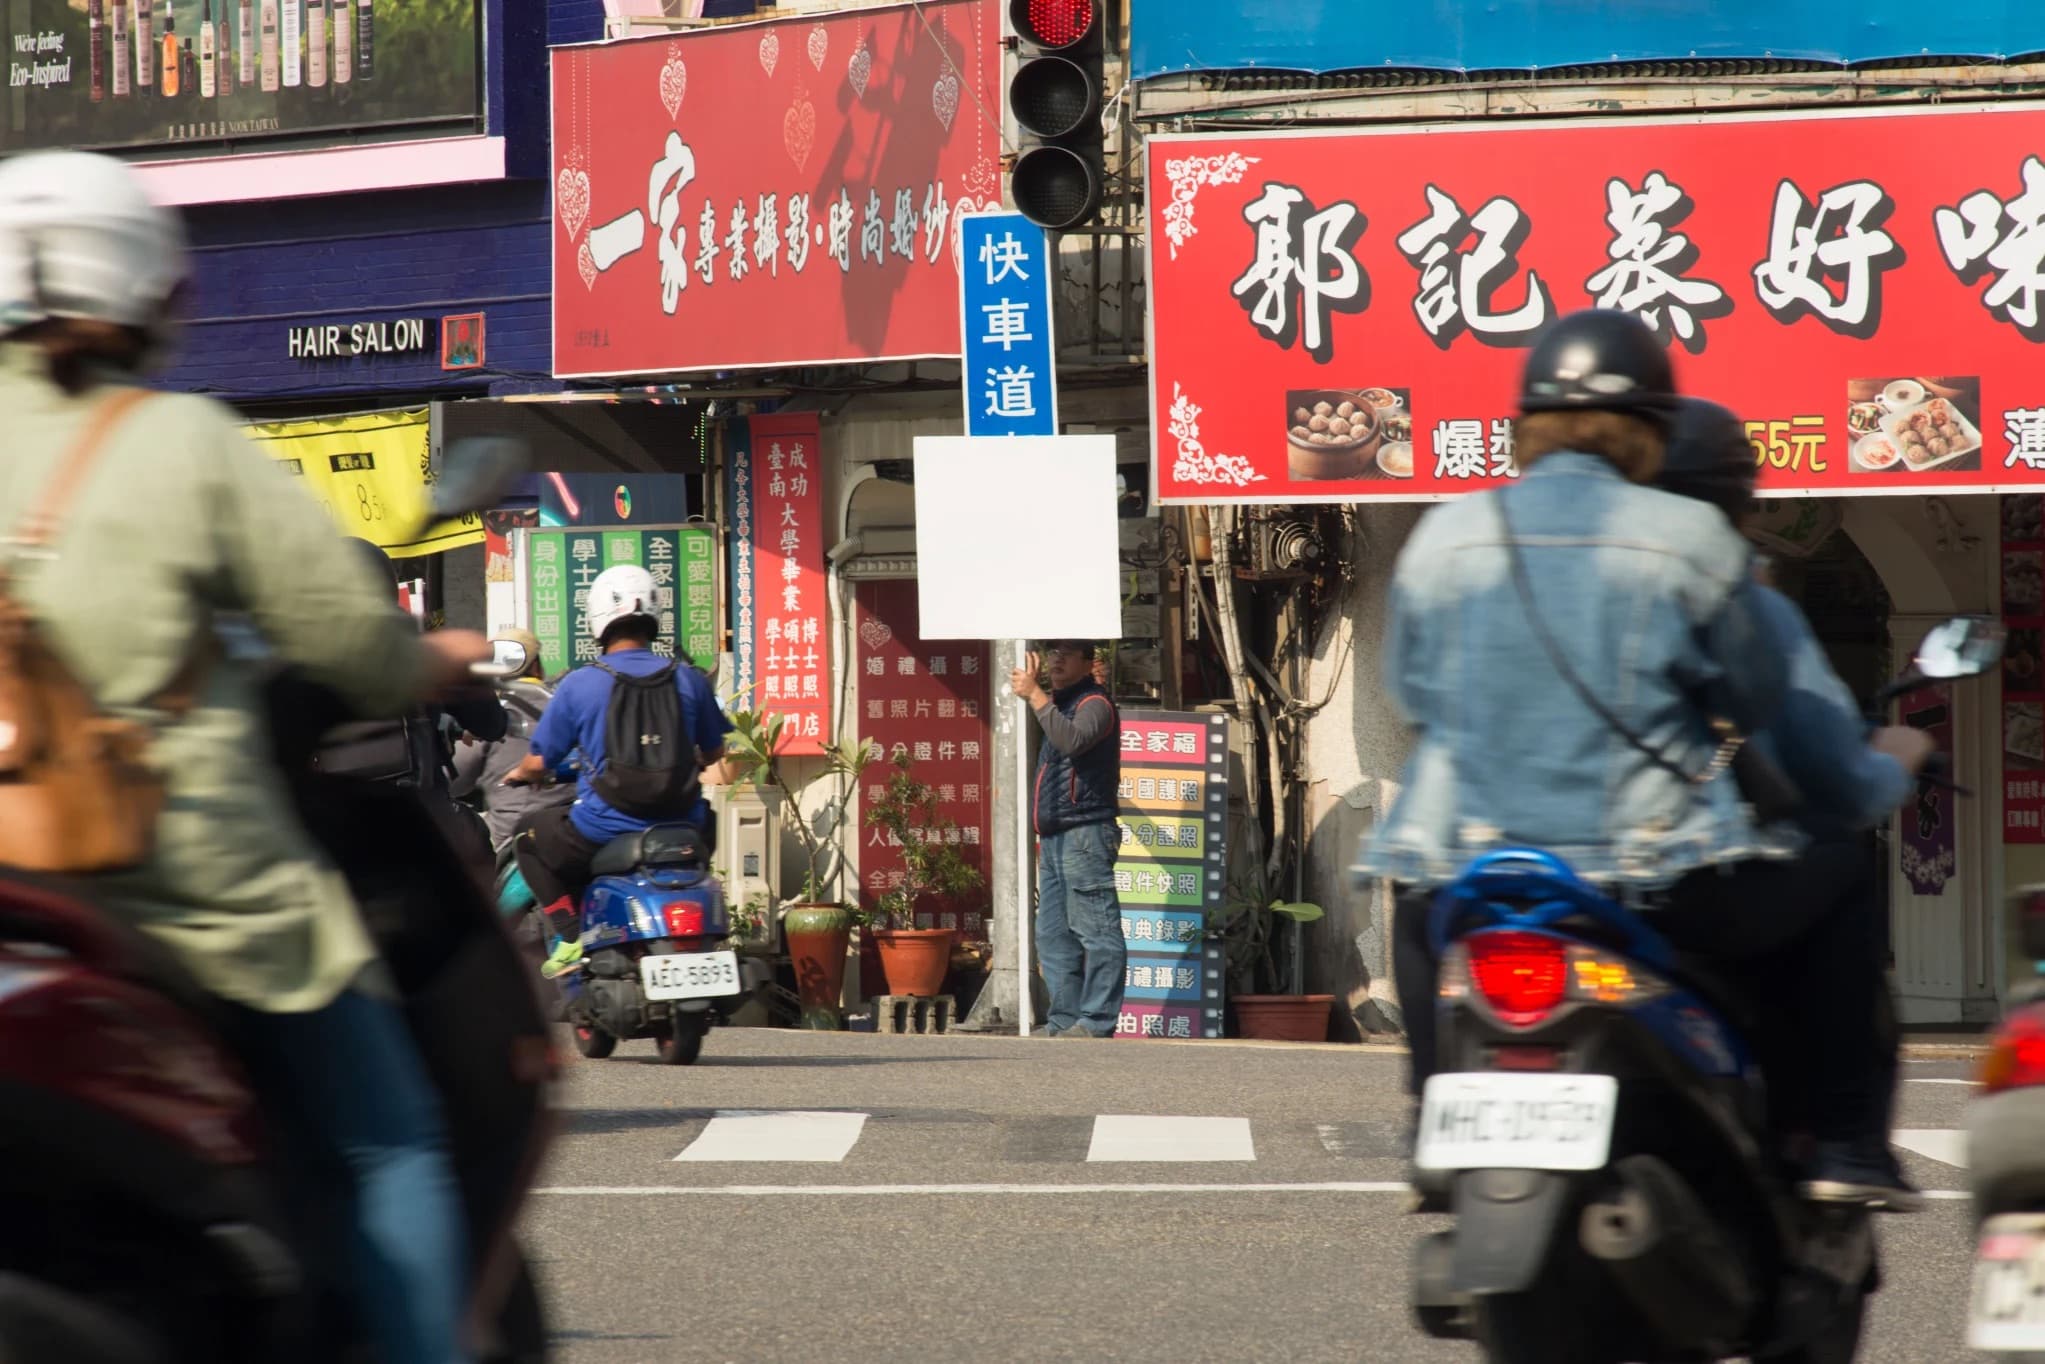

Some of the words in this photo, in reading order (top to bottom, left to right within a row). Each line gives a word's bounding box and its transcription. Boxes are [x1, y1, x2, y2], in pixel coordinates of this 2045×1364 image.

[37, 31, 64, 54] feeling
[289, 325, 340, 358] HAIR
[351, 319, 424, 355] SALON
[979, 231, 1037, 437] 快車道
[789, 442, 808, 497] 成功
[534, 540, 560, 661] 身份出國照
[802, 617, 819, 698] 博士照
[866, 656, 979, 676] 婚禮攝影
[1119, 730, 1197, 754] 全家福
[650, 963, 734, 988] AEC-5893
[1116, 1012, 1192, 1039] 拍照處
